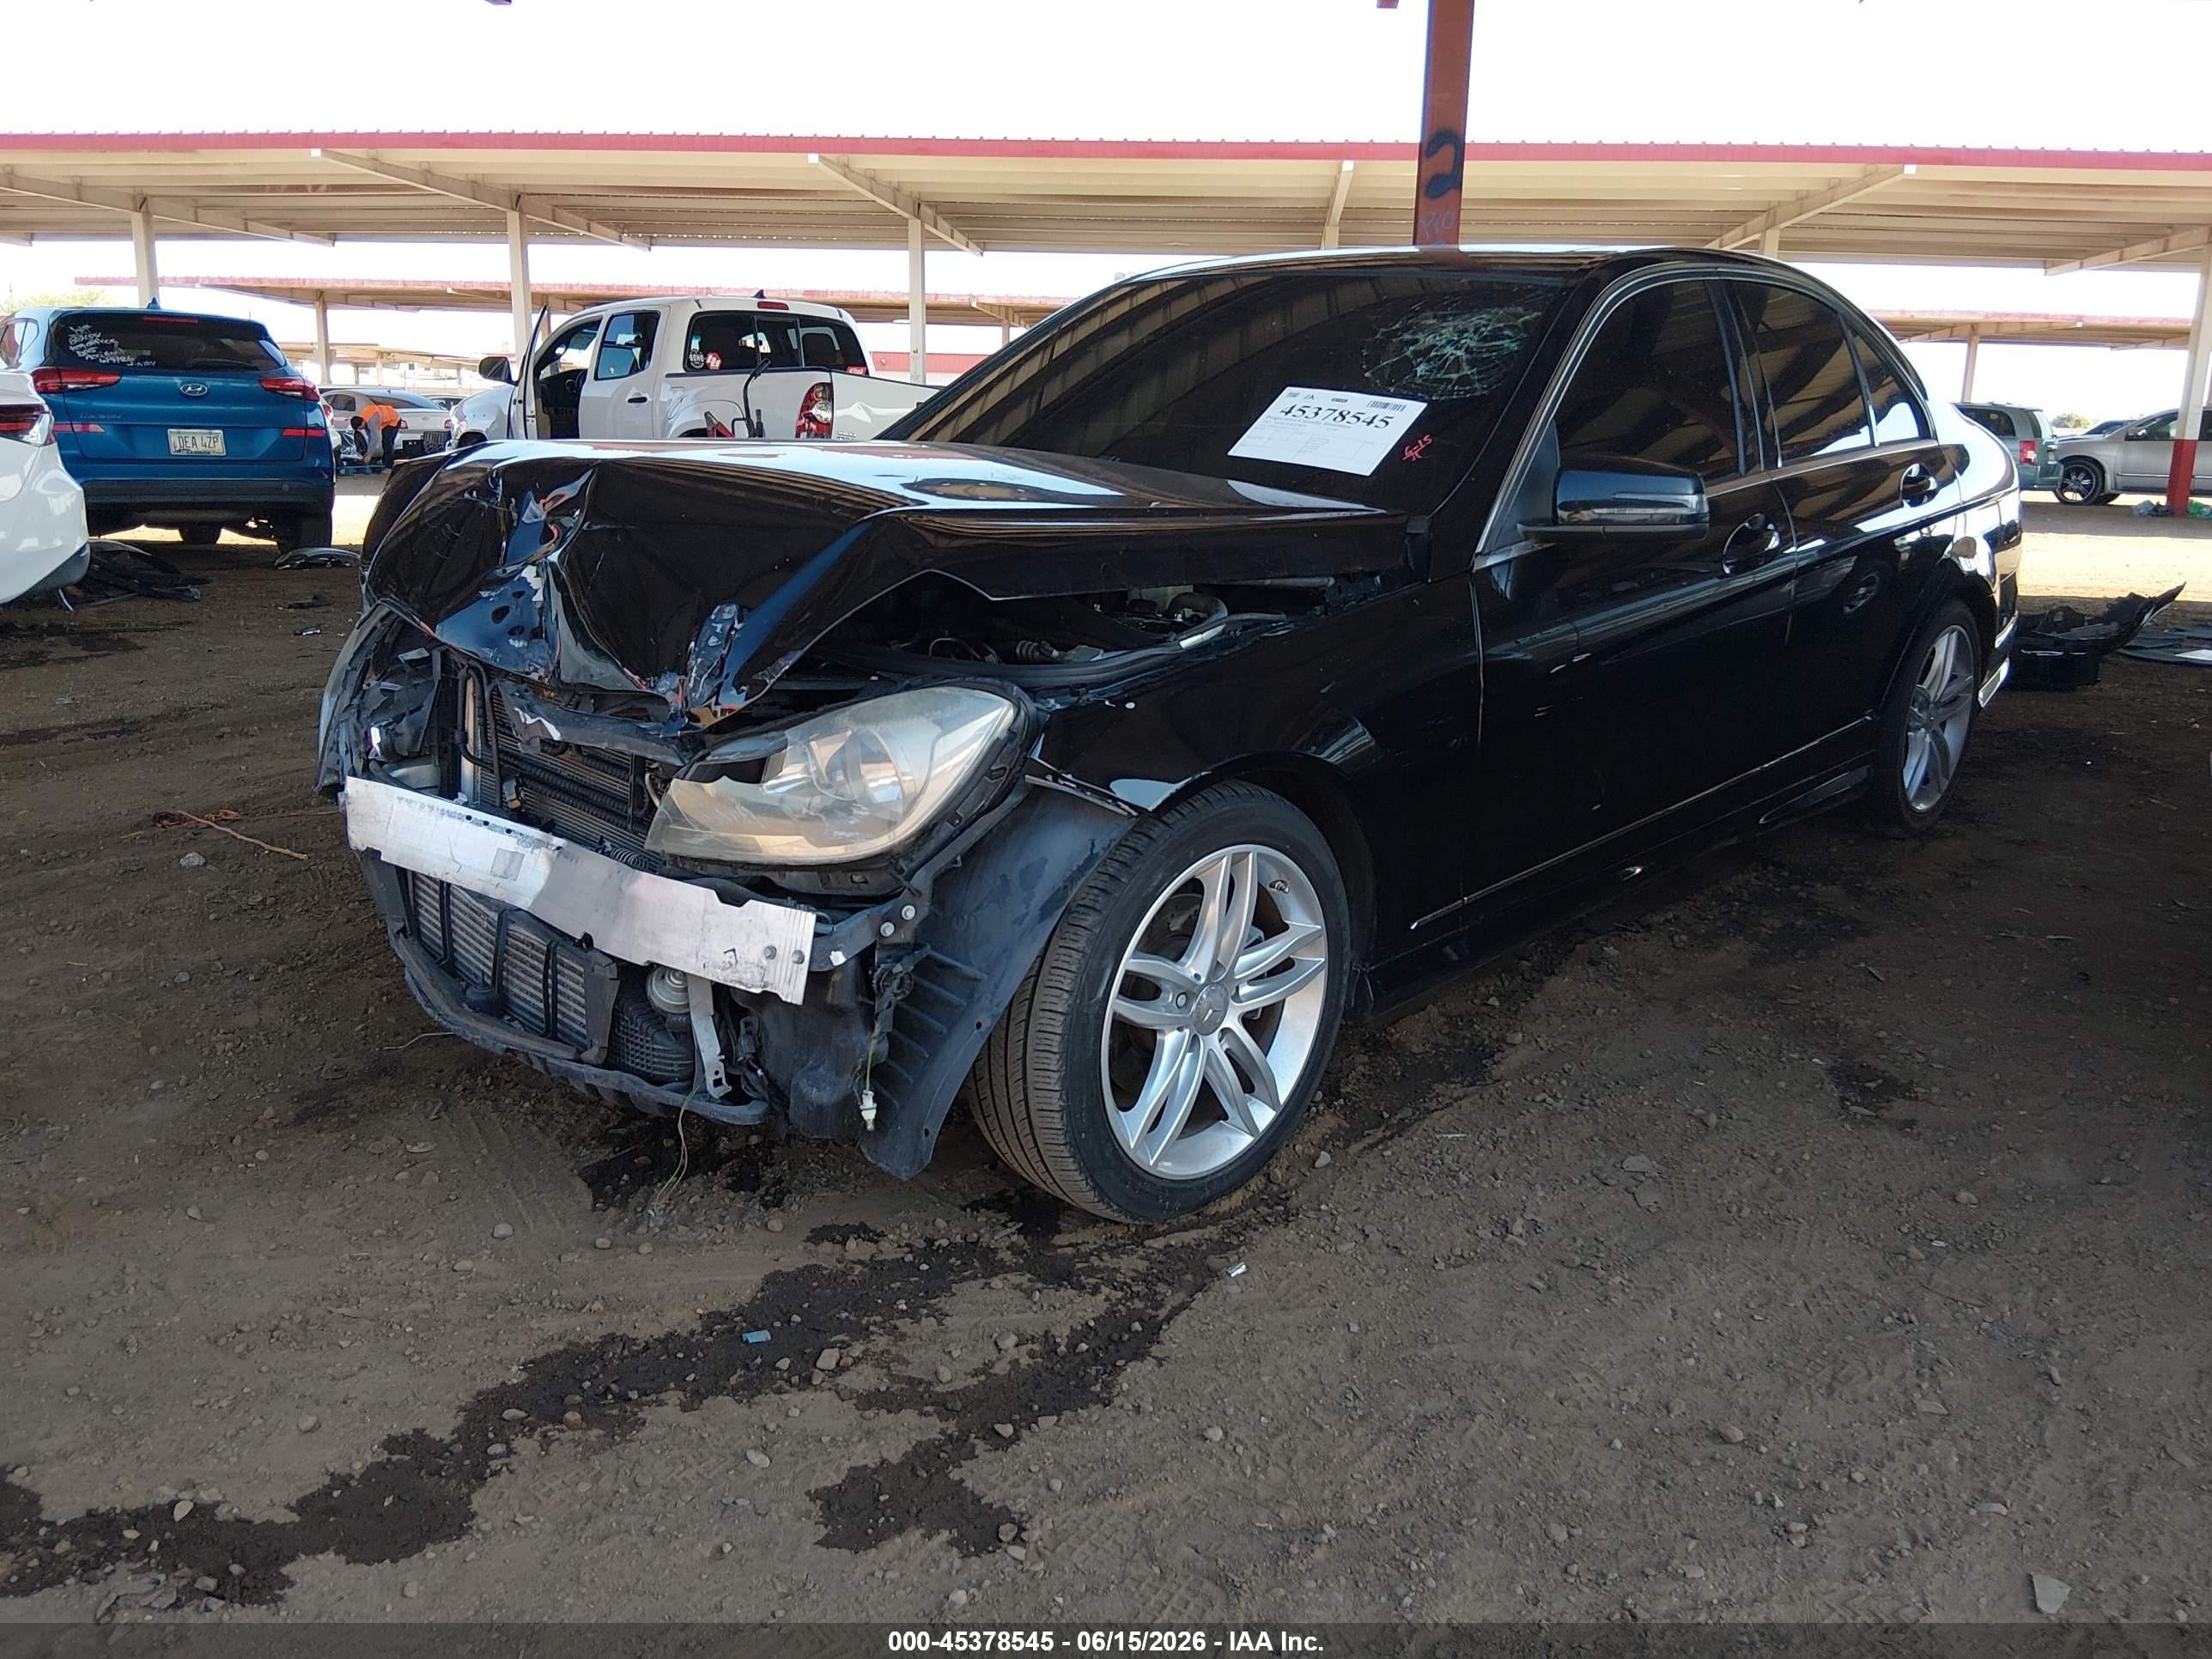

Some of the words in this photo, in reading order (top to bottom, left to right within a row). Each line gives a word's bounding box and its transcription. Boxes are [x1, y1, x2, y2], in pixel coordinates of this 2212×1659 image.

[1425, 131, 1462, 198] 2
[1279, 404, 1395, 429] 45378545
[178, 435, 198, 448] DEA
[201, 436, 219, 449] 4ZP
